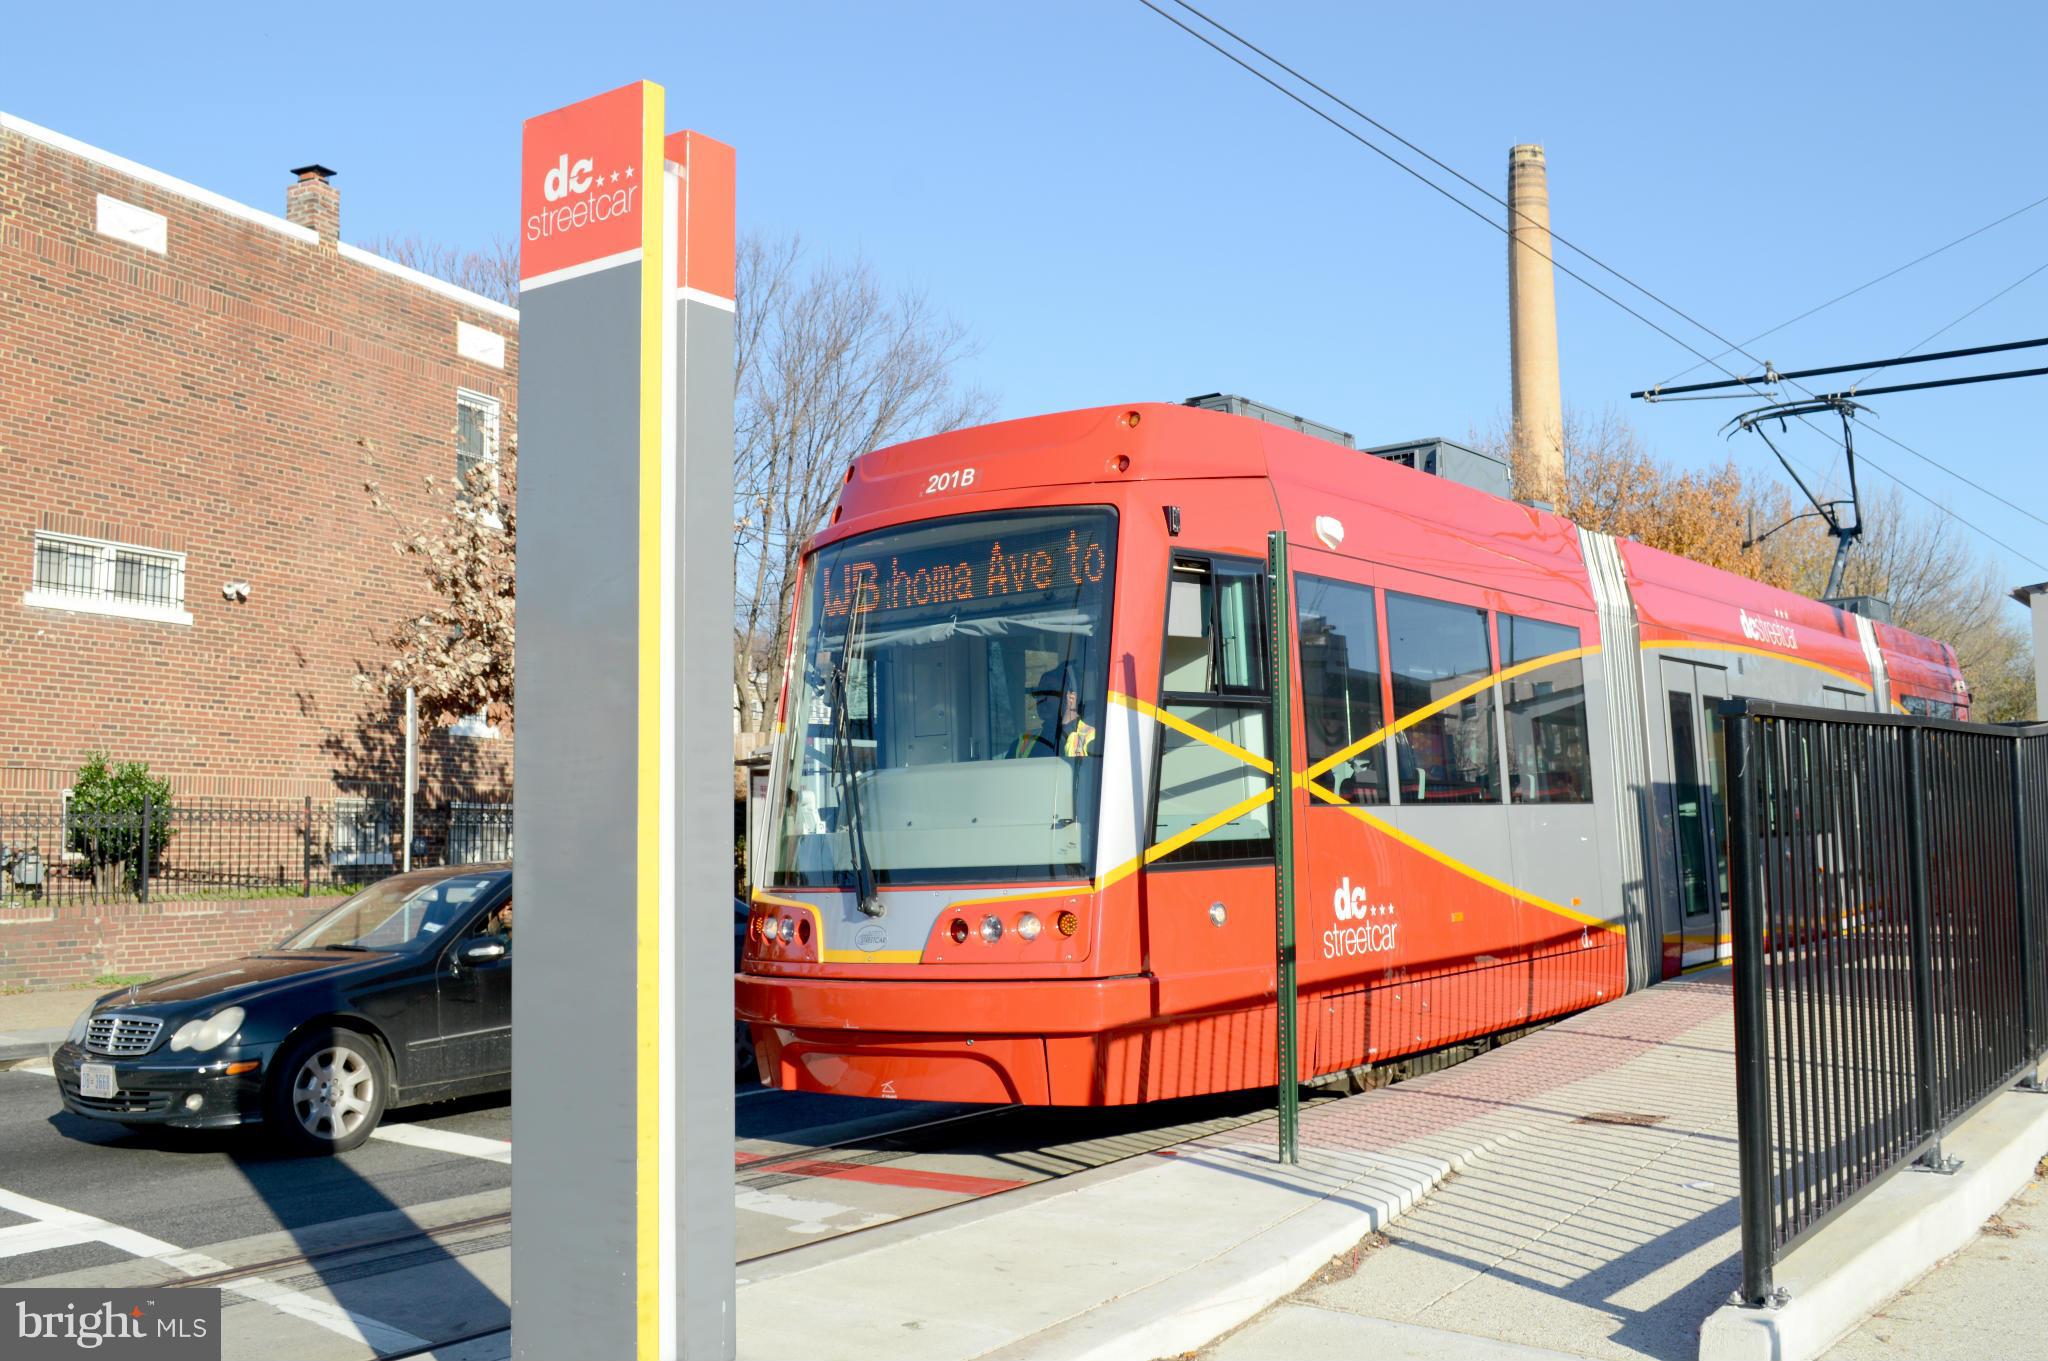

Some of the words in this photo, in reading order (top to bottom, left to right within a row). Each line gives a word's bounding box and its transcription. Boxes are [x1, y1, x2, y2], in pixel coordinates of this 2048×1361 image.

[543, 153, 593, 202] dc
[527, 184, 638, 241] streetcar
[925, 468, 975, 494] 201B
[823, 561, 880, 617] WB
[886, 555, 974, 609] homa
[987, 541, 1054, 597] Ave
[1064, 529, 1106, 585] to
[1333, 876, 1368, 921] dc
[1323, 919, 1398, 959] streetcar
